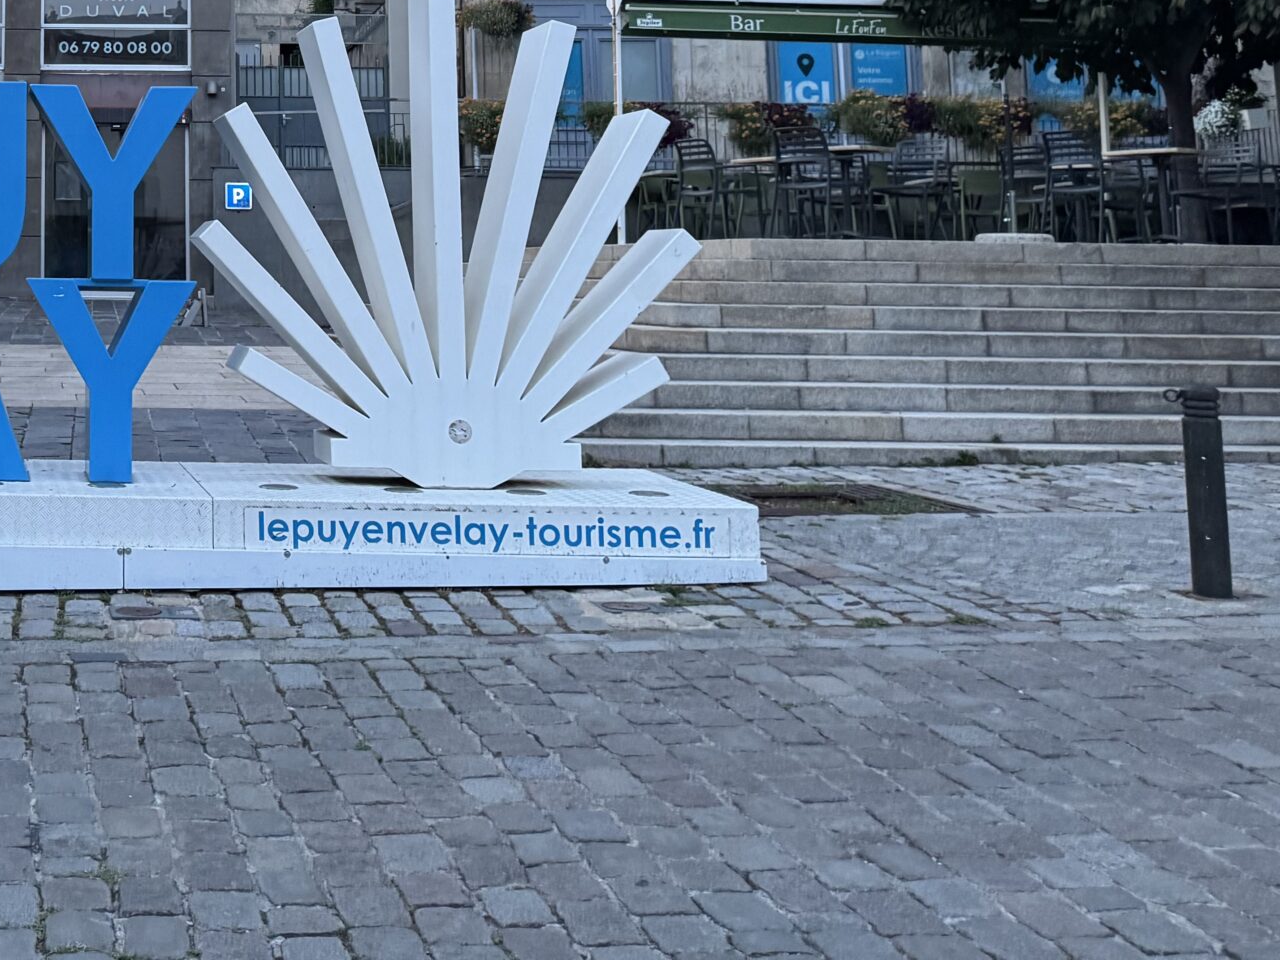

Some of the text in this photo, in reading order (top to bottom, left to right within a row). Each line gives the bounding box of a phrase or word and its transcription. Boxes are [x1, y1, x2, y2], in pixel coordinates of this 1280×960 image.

[59, 4, 173, 18] DUVAL
[729, 14, 765, 31] Bar
[835, 18, 849, 34] Le
[58, 40, 173, 54] 06 79 80 08 00
[232, 187, 245, 205] P
[258, 510, 716, 553] lepuyenvelay-tourisme.fr
